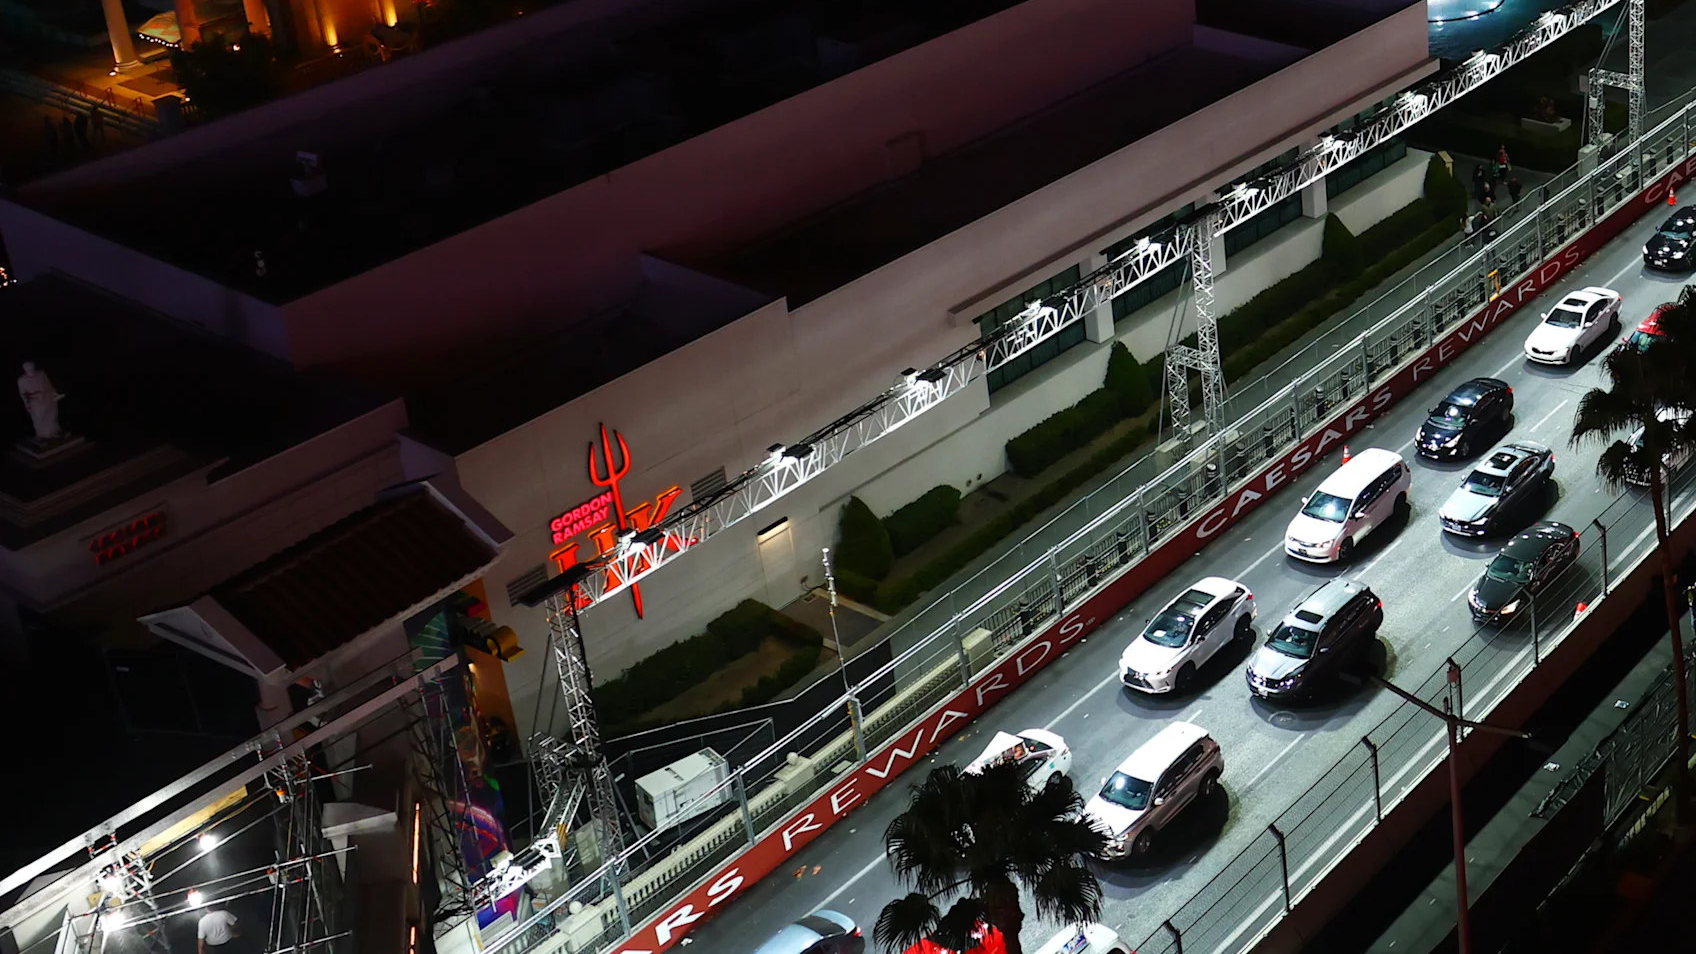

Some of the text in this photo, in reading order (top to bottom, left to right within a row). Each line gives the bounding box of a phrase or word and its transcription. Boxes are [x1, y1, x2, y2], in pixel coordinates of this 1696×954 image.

[1196, 246, 1581, 538] CAESARS REWARDS
[550, 491, 614, 532] GORDON
[552, 505, 610, 545] RAMSAY
[782, 614, 1086, 851] REWARDS
